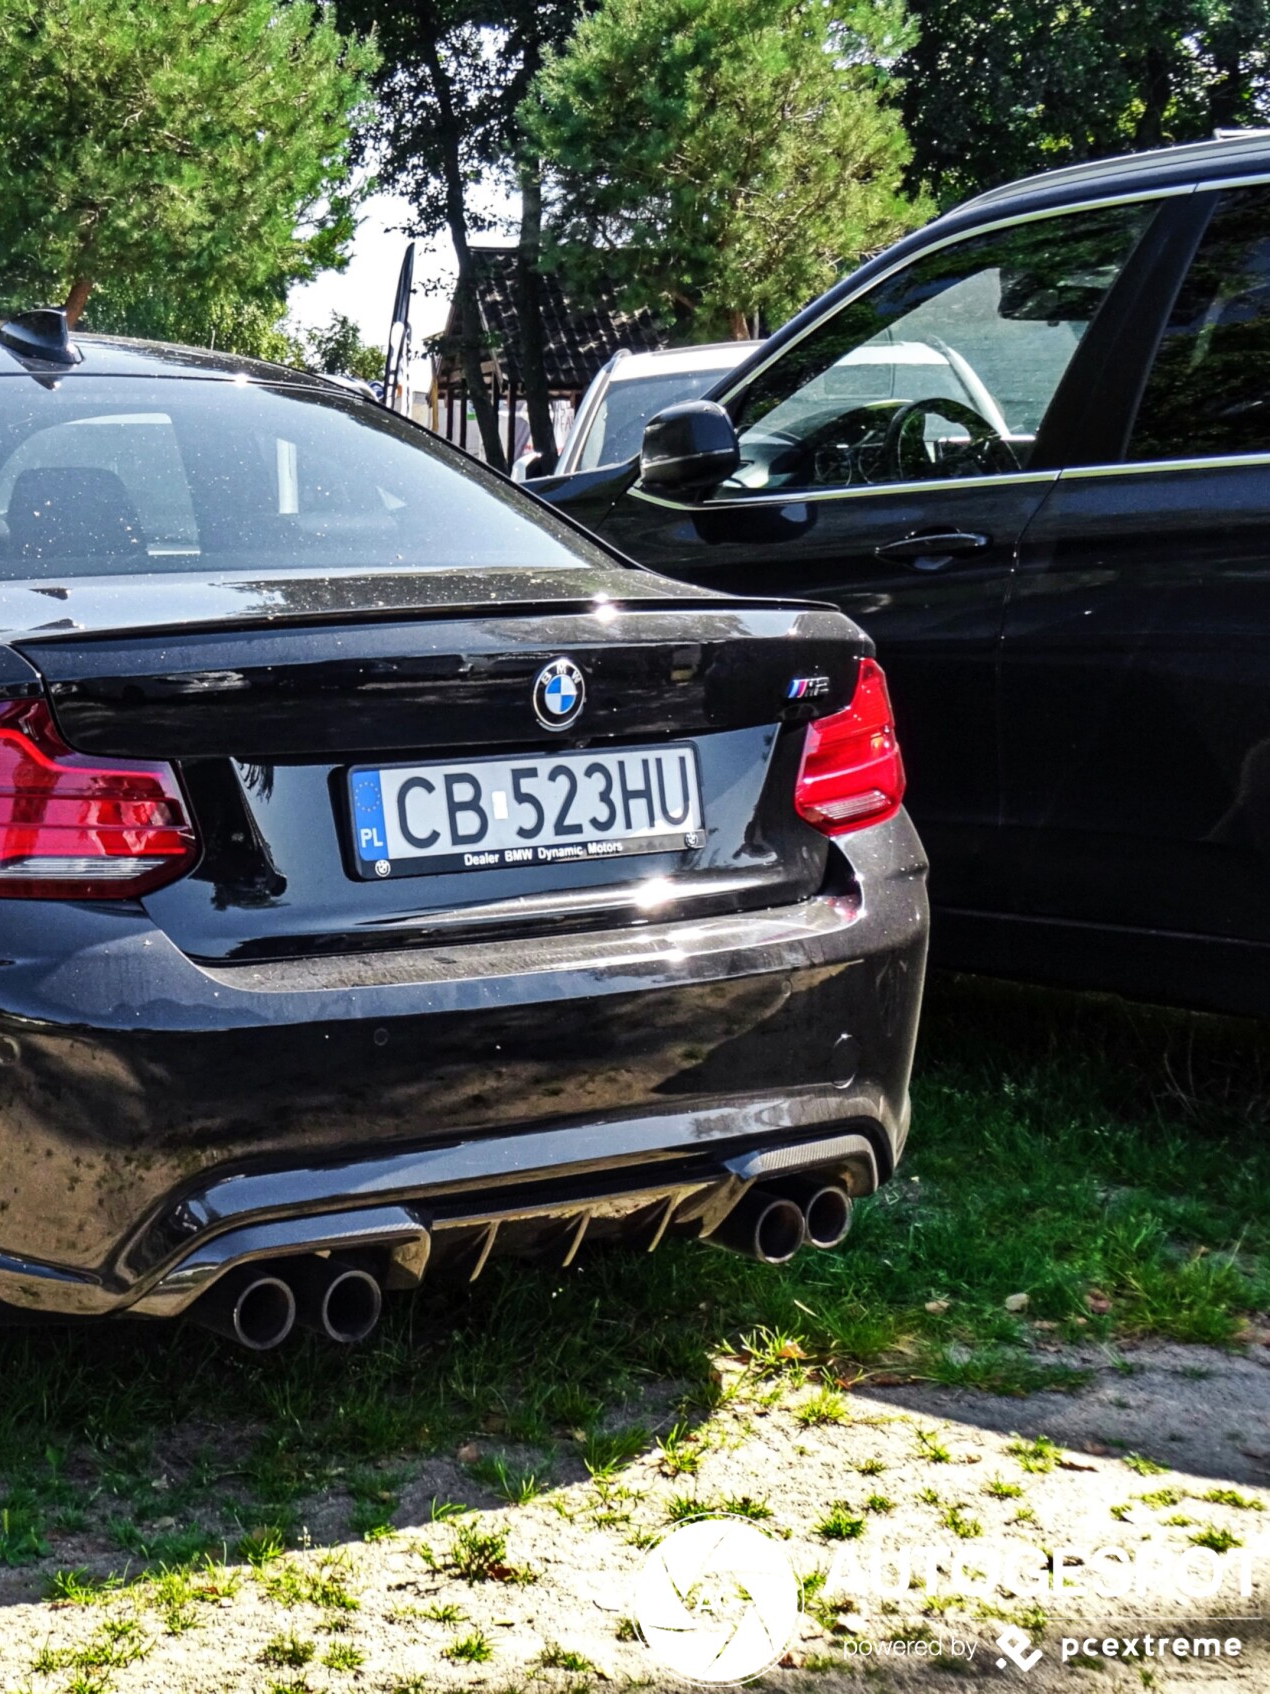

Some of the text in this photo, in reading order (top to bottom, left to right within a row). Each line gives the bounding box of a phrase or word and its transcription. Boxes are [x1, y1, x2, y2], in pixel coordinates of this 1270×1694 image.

[540, 661, 582, 686] BMW
[396, 755, 691, 850] CB 523HU
[360, 827, 384, 849] PL
[464, 841, 623, 866] Dealer BMW Dynamic Motors
